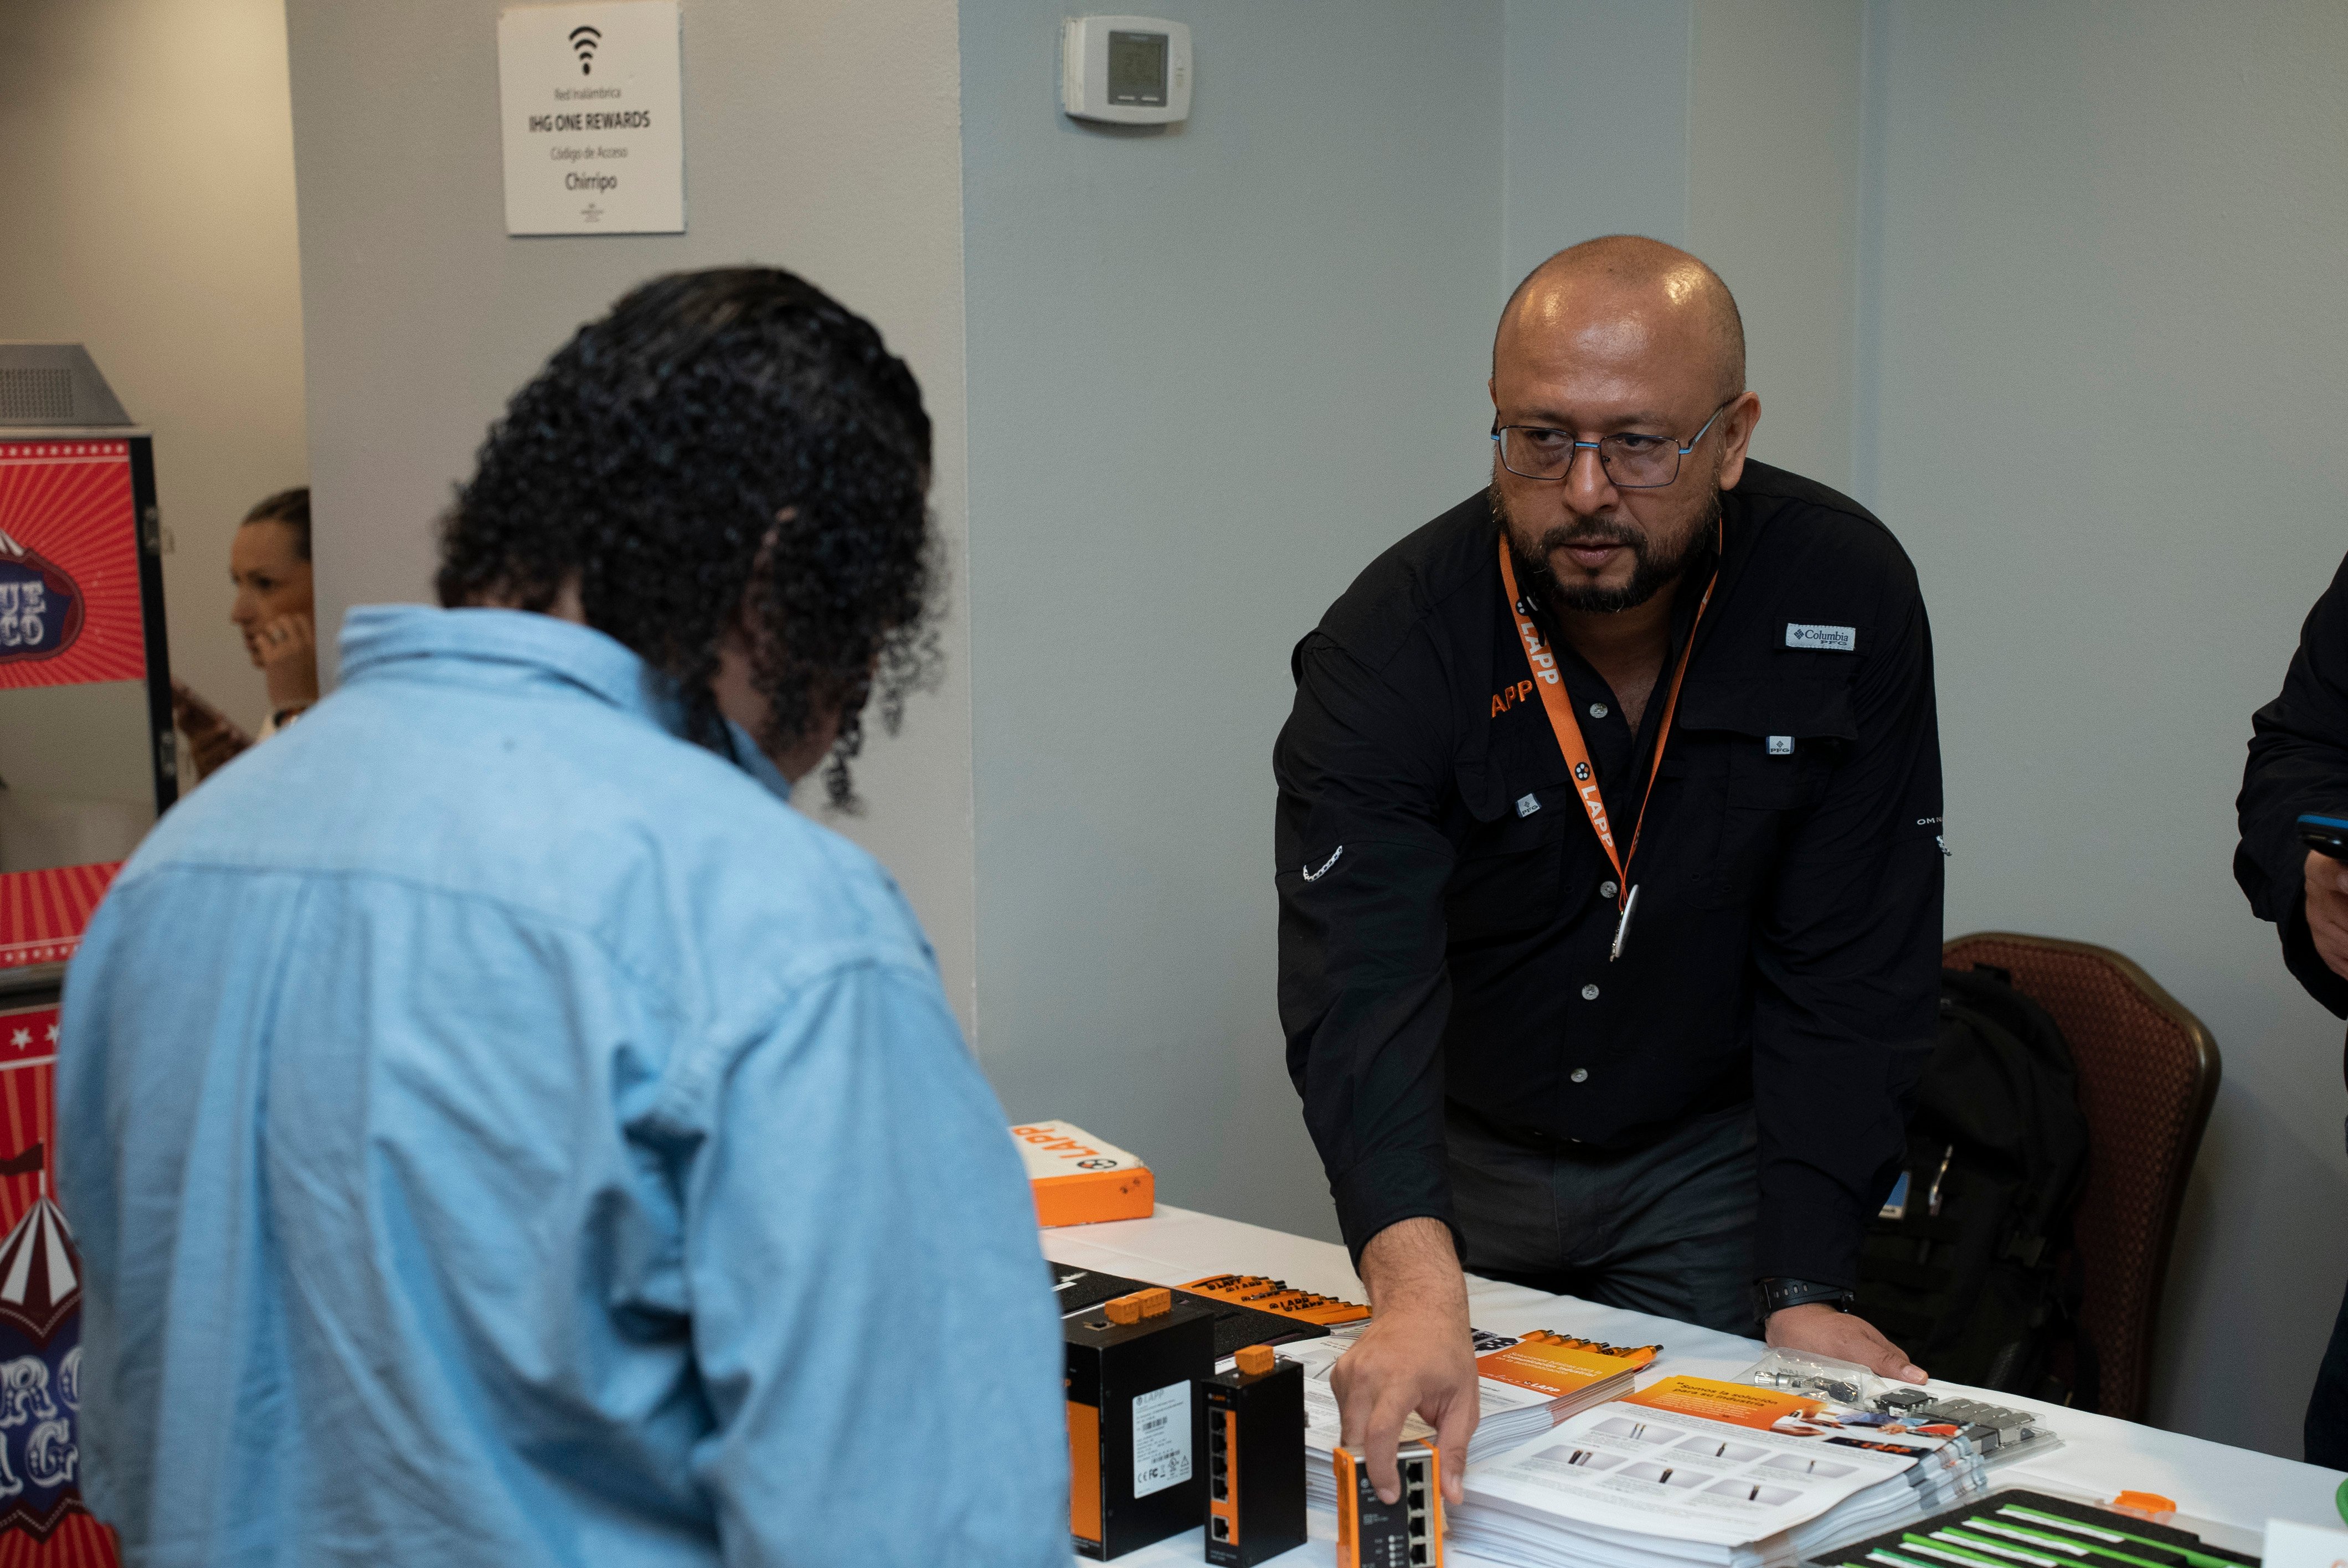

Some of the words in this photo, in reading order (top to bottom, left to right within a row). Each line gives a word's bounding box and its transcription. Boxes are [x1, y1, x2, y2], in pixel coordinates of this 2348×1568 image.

[529, 115, 552, 132] IHG
[555, 114, 582, 132] ONE
[586, 110, 651, 130] REWARDS
[584, 146, 594, 159] de
[598, 146, 628, 159] Acceso
[1805, 629, 1848, 642] Columbia
[1521, 621, 1559, 685] LAPP
[1522, 804, 1538, 815] PFG
[1581, 785, 1613, 848] LAPP
[1012, 1126, 1100, 1159] LAPP
[1531, 1383, 1561, 1392] LAPP
[1716, 1395, 1765, 1407] industria
[1732, 1394, 1778, 1405] solución
